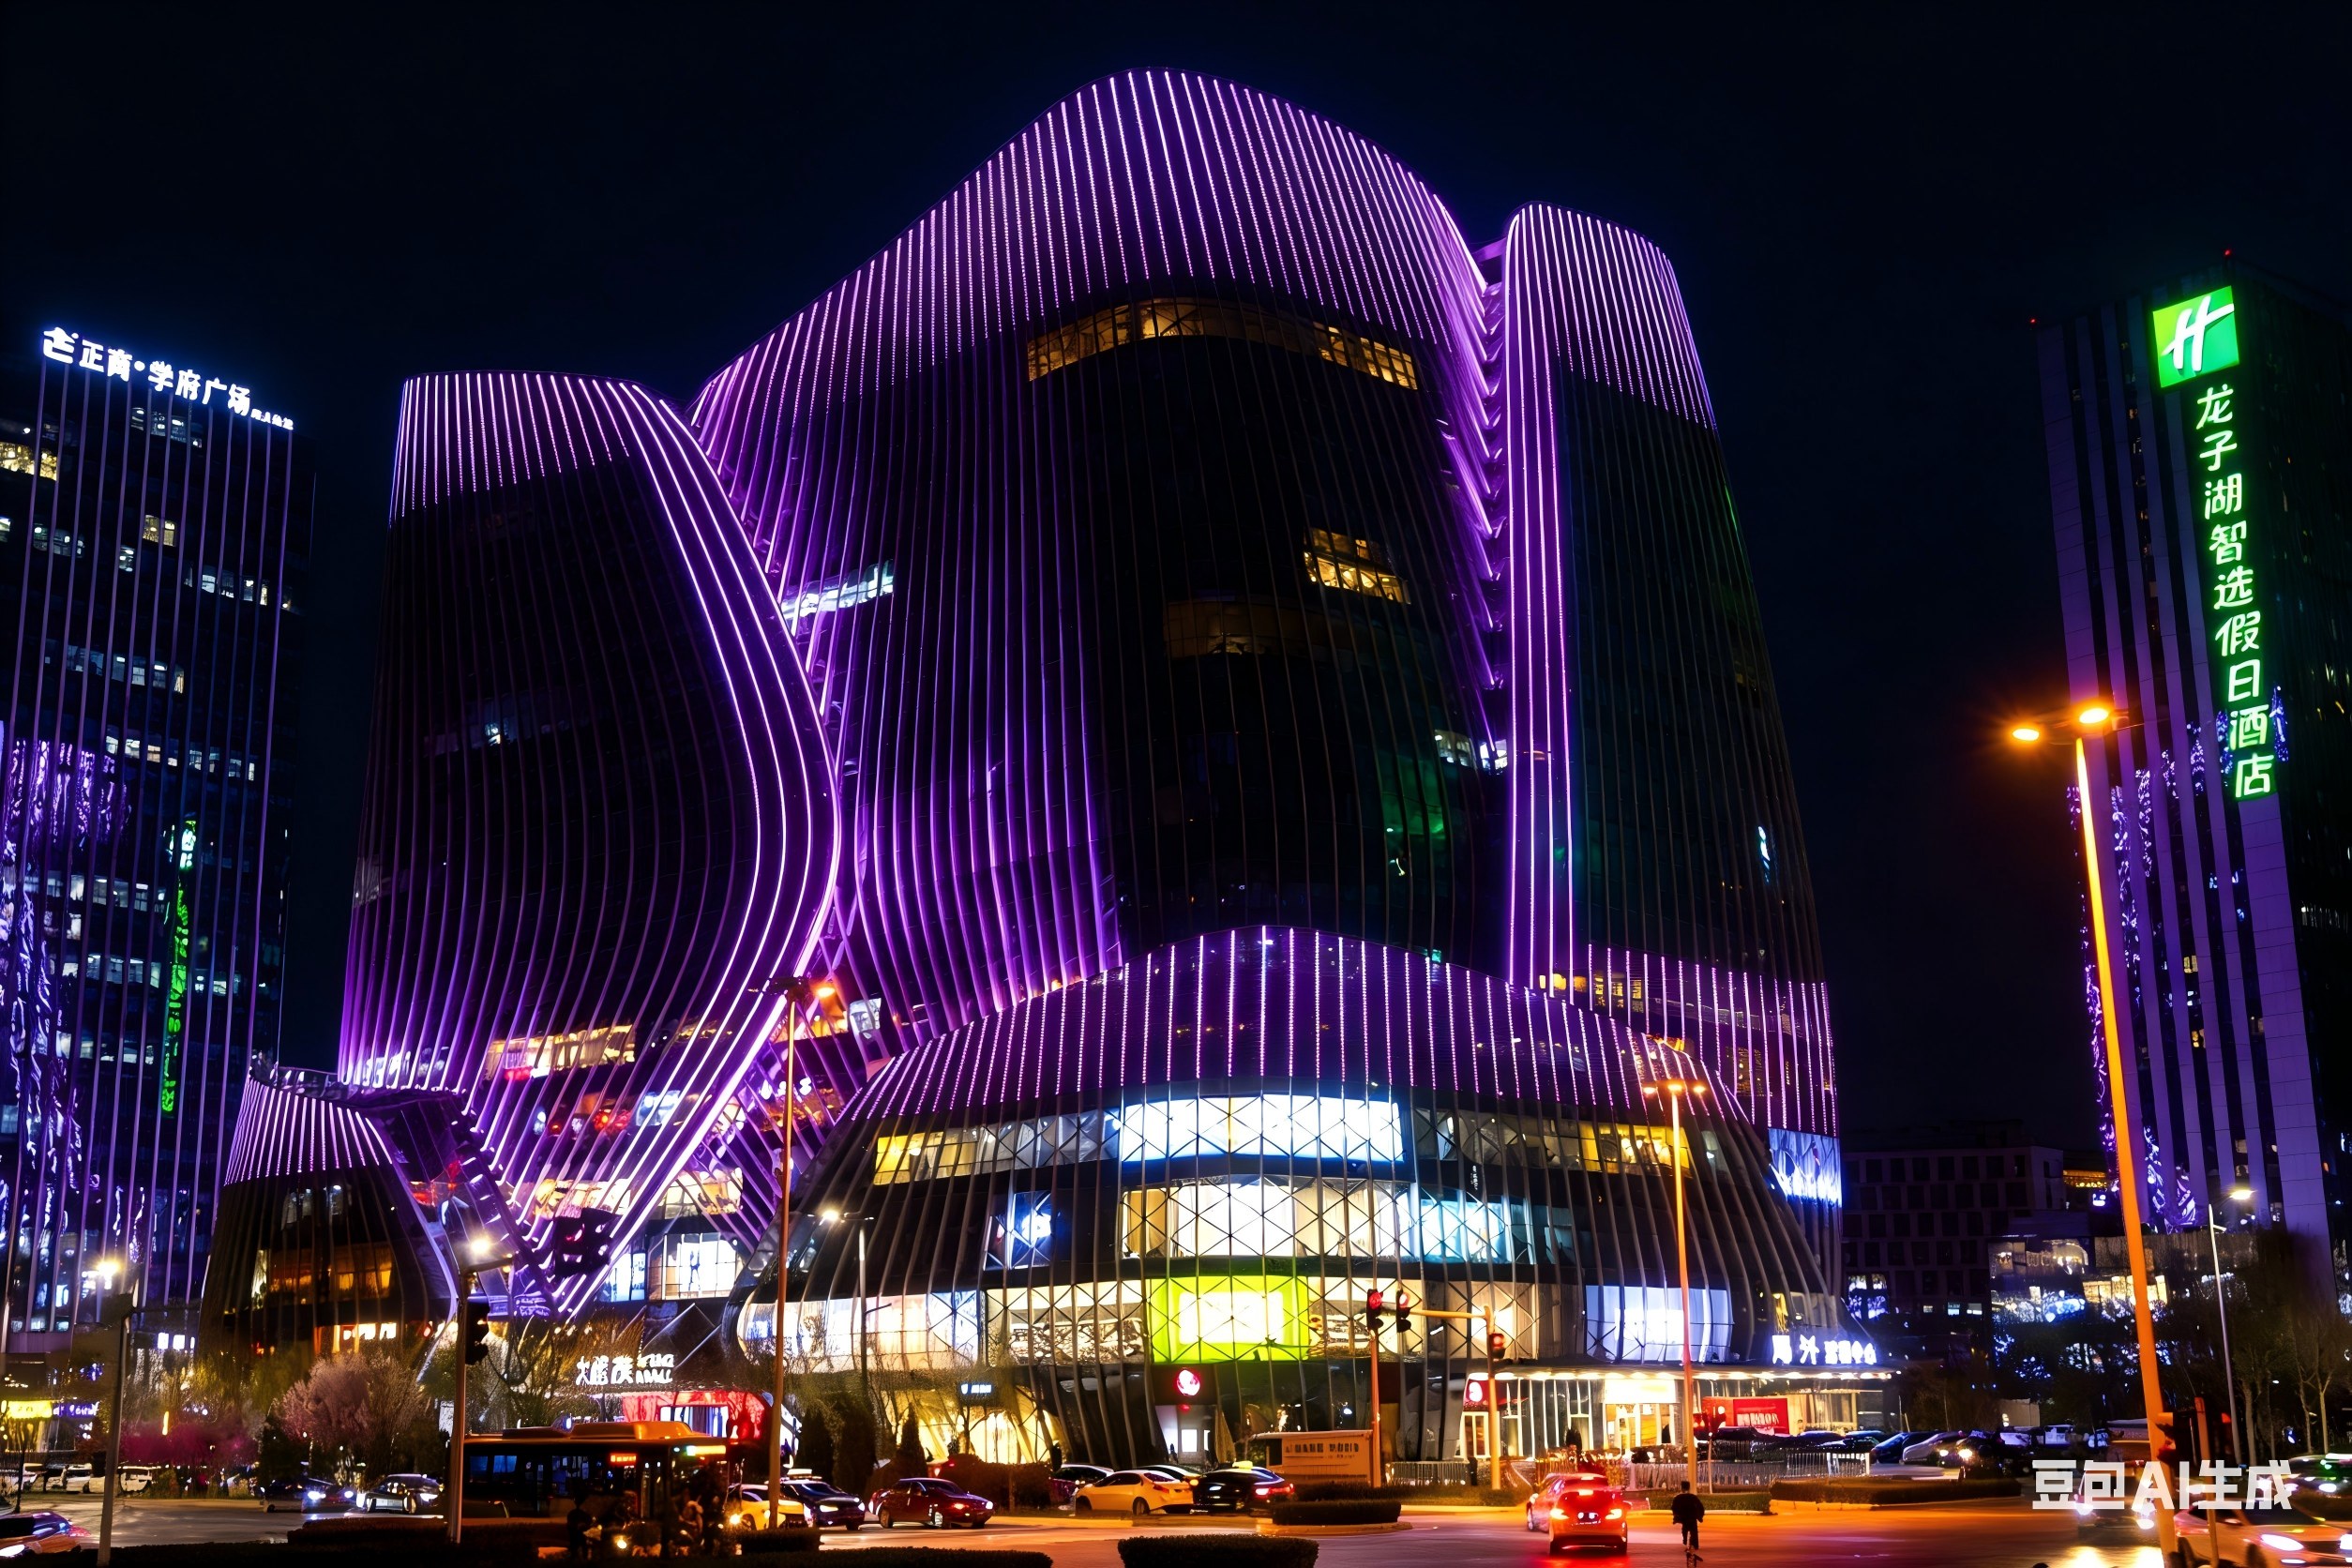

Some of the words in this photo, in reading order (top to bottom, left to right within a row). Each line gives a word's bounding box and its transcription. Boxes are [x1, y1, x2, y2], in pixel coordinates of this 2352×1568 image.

[2195, 383, 2275, 798] 龙子湖智选假日酒店
